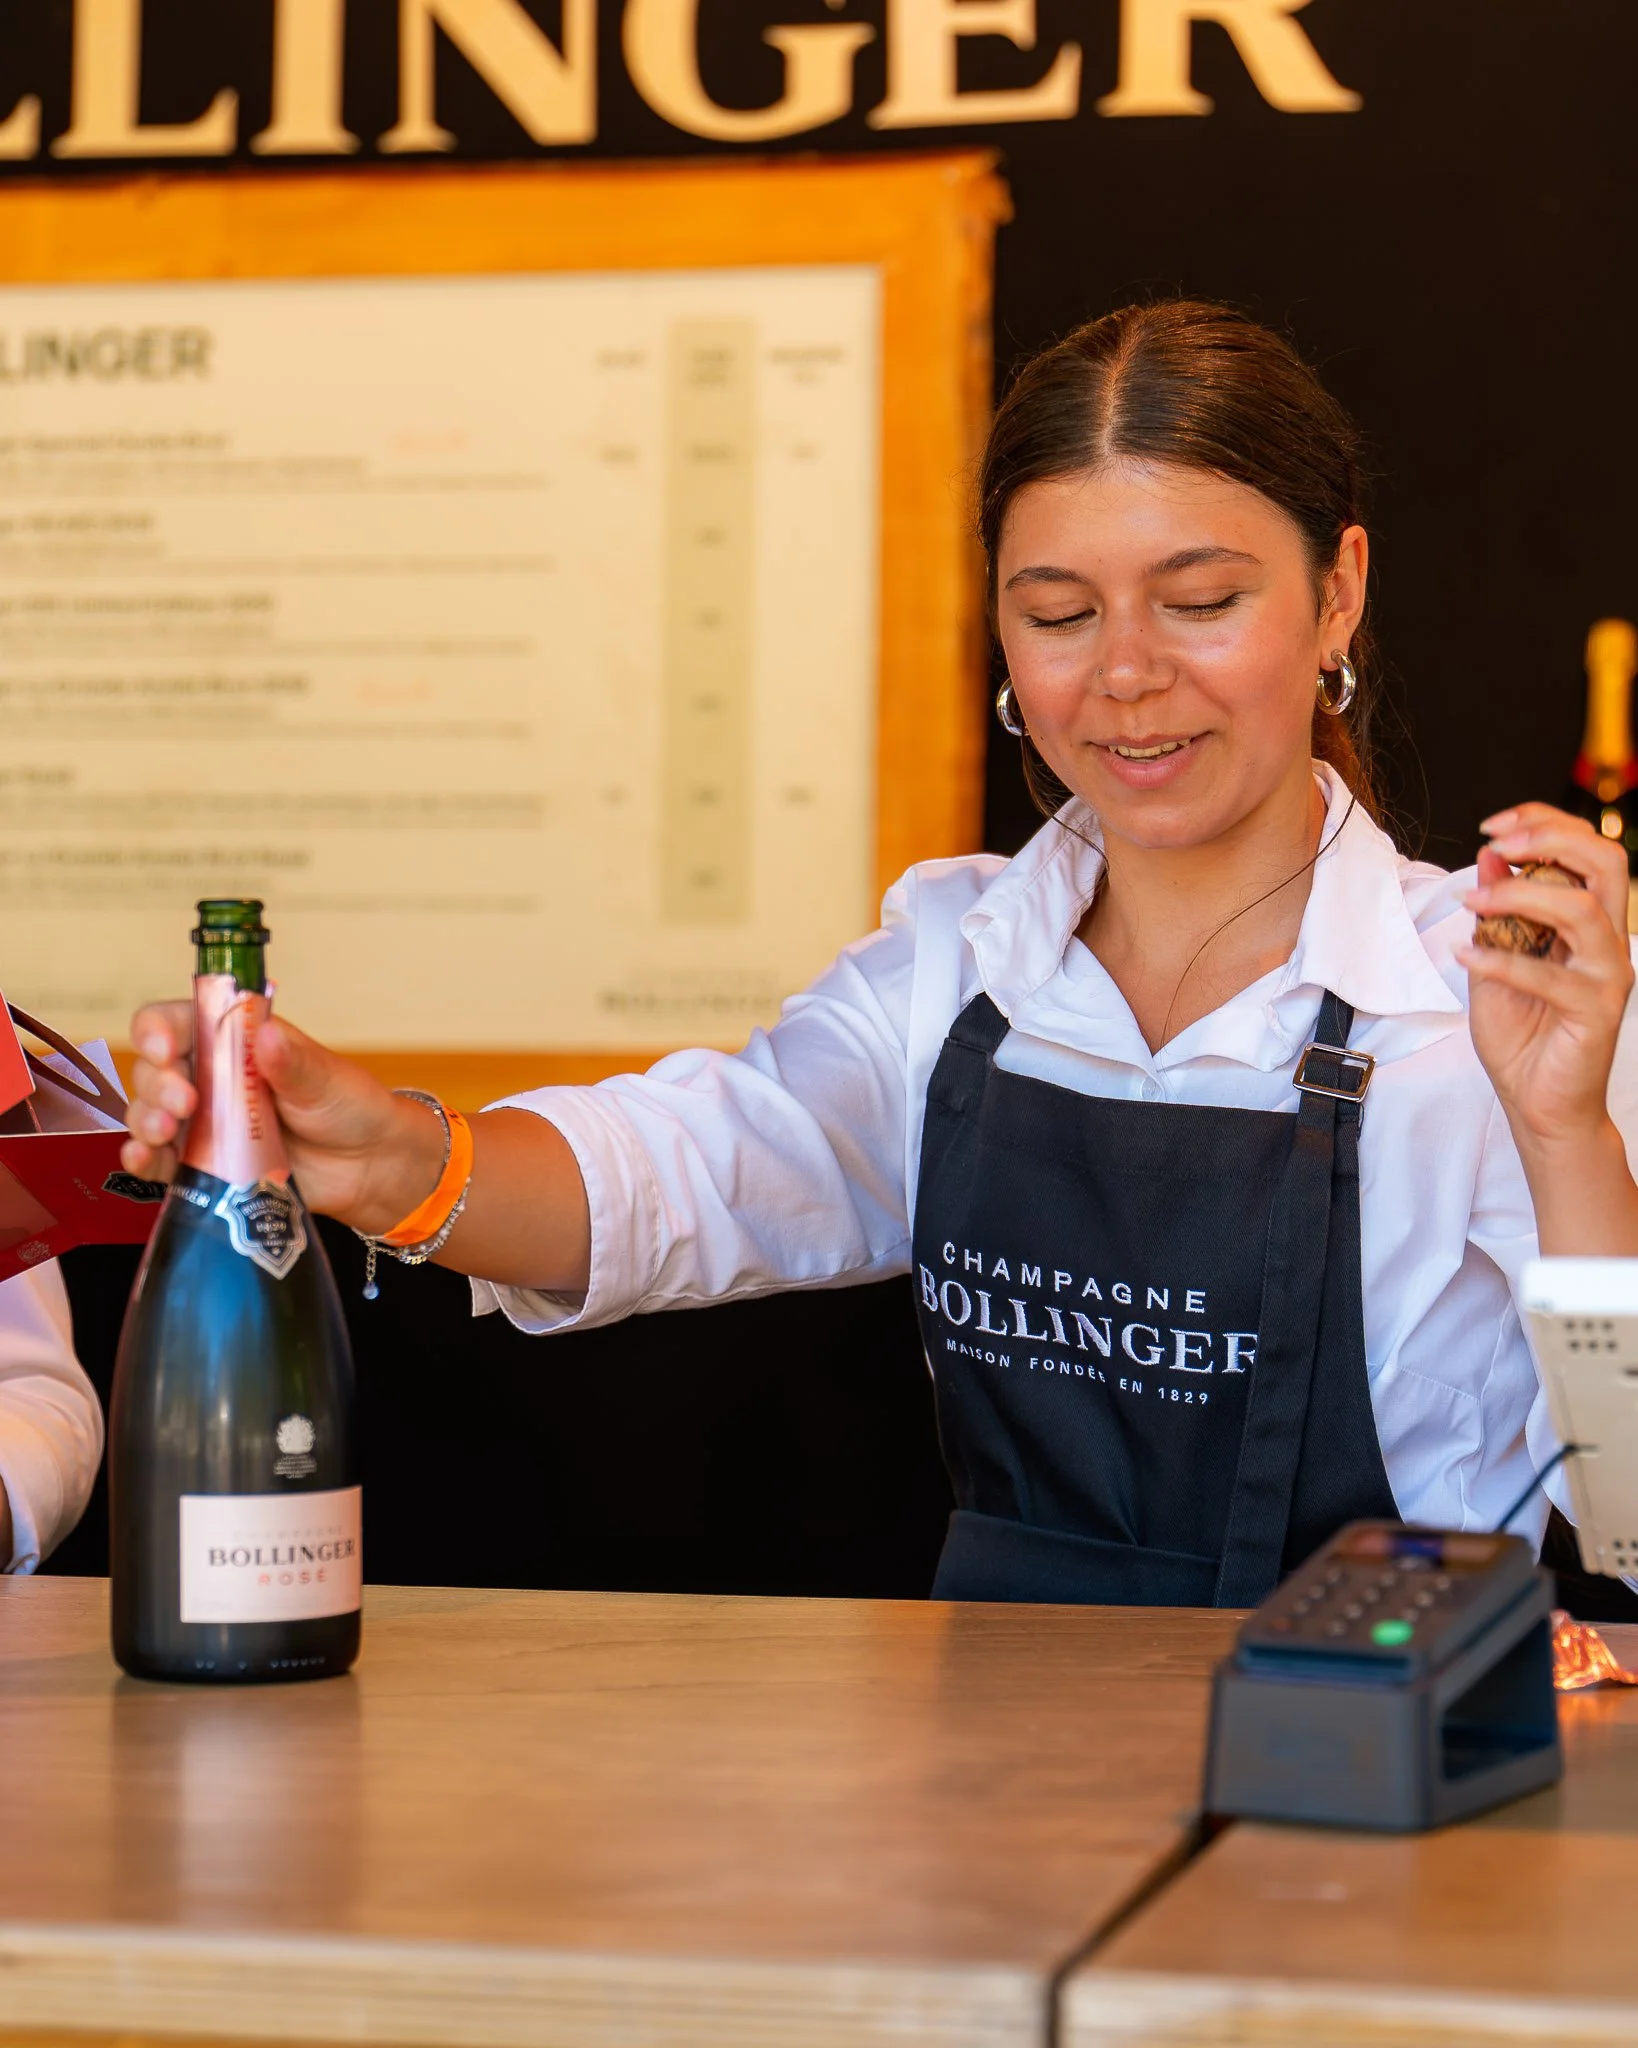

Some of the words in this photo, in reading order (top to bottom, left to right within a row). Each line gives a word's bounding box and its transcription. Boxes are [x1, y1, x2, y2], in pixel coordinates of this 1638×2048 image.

[0, 0, 1363, 160] LINGER
[942, 1241, 1207, 1314] CHAMPAGNE
[946, 1338, 1011, 1368] MAISON
[1119, 1377, 1143, 1394] EN
[1157, 1387, 1209, 1405] 1829
[208, 1538, 356, 1567] BOLLINGER
